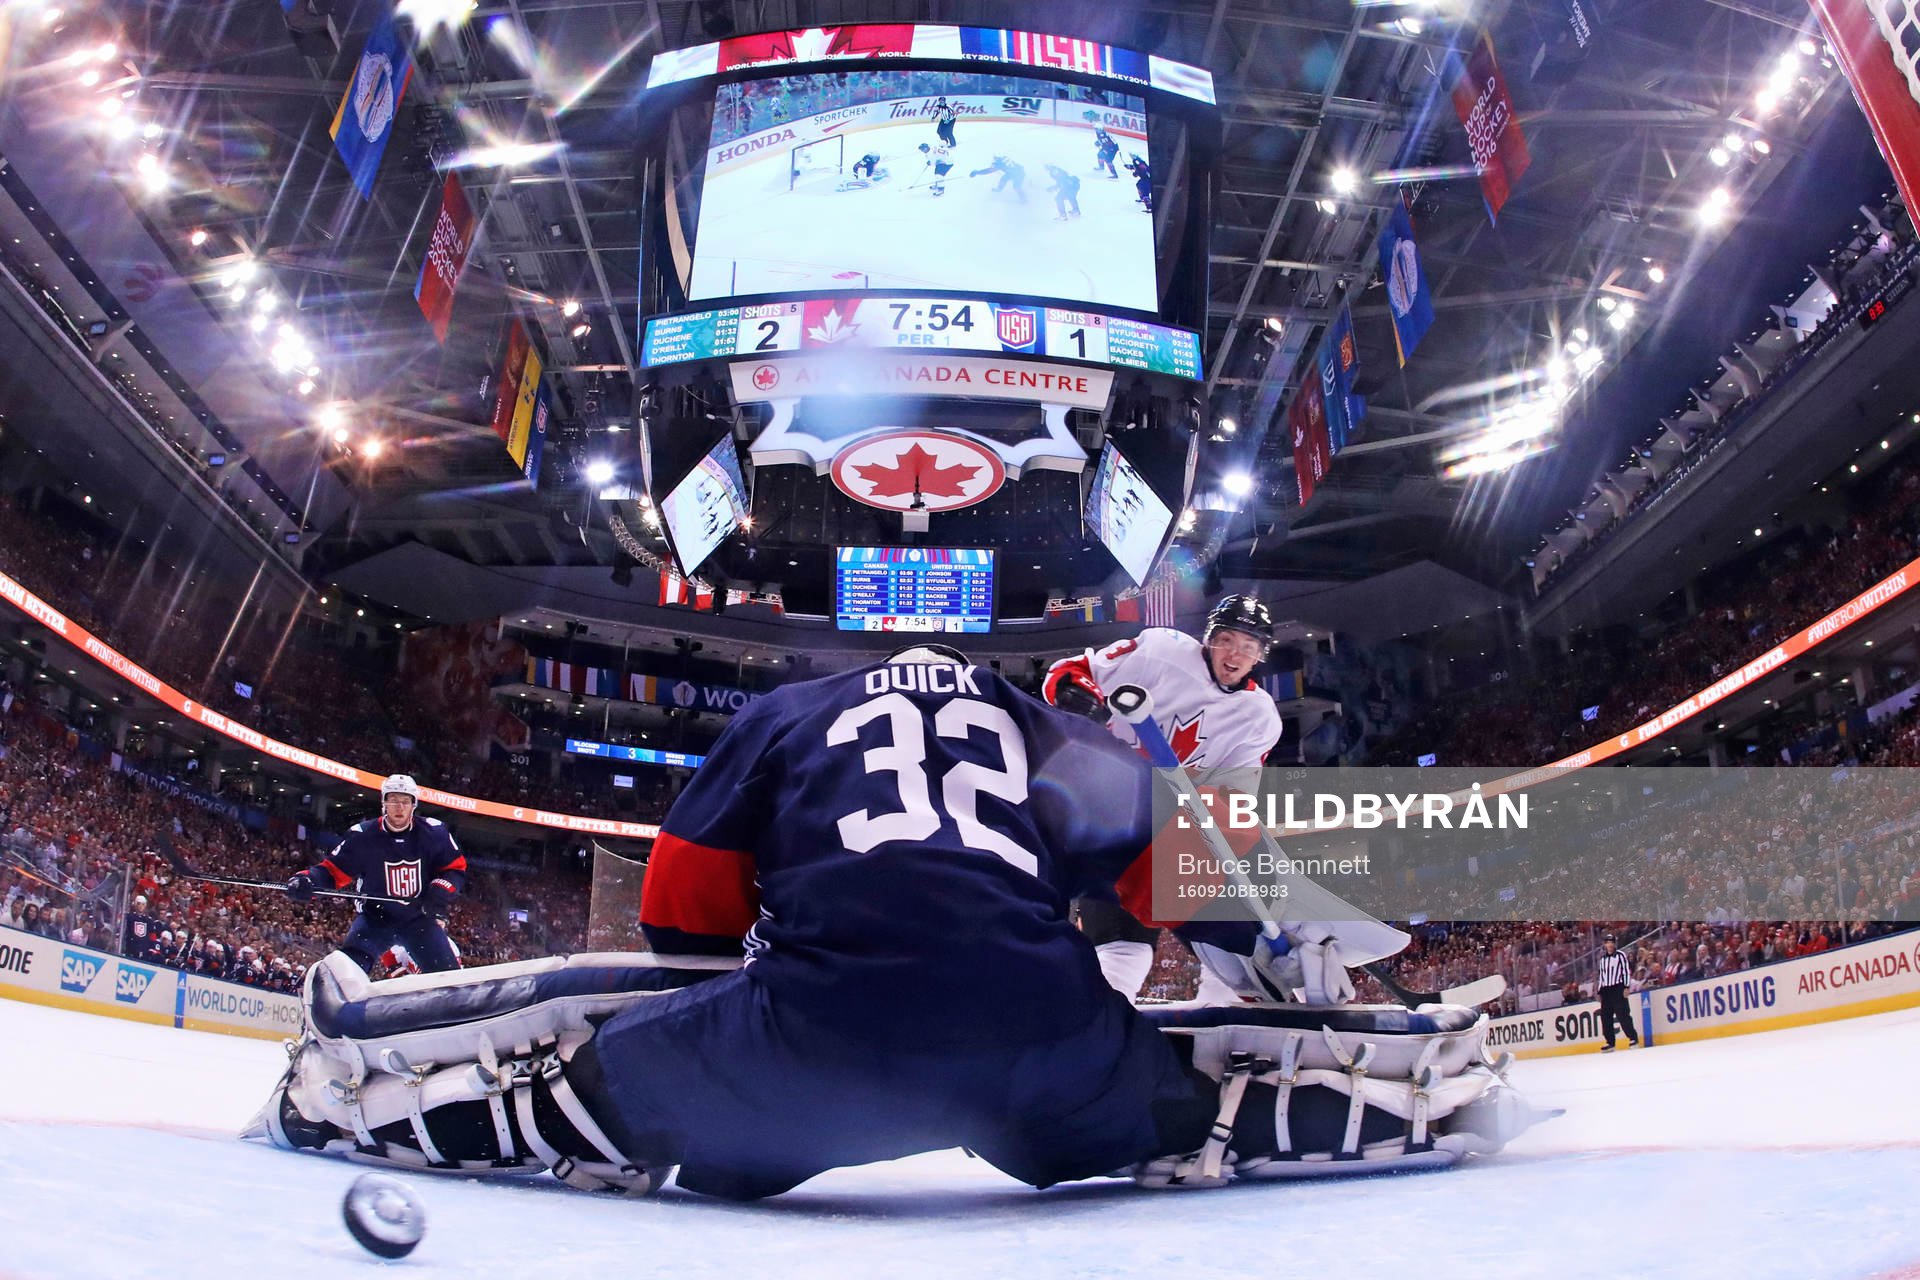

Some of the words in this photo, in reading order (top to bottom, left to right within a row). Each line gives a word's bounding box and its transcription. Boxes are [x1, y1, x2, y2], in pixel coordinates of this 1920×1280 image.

[889, 101, 917, 119] Tim
[920, 99, 988, 116] Htons.
[1001, 96, 1042, 111] SN
[1464, 76, 1496, 134] WORLD
[1468, 114, 1486, 148] CUP
[1471, 99, 1507, 163] HOCKEY
[716, 128, 797, 164] HONDA
[655, 312, 712, 326] PIETRANGELO
[744, 305, 782, 318] SHOTS
[790, 304, 797, 313] 5
[888, 303, 974, 331] 7:54
[1049, 310, 1086, 324] SHOTS
[1094, 316, 1101, 325] 8
[654, 326, 682, 336] BURNS
[1108, 318, 1148, 330] JOHNSON
[653, 334, 692, 346] DUCHENE
[755, 320, 780, 351] 2
[897, 333, 934, 346] PER
[1070, 328, 1086, 358] 1
[1109, 328, 1155, 342] BYFUGLIEN
[1109, 337, 1159, 352] PACIORETTY
[650, 352, 695, 364] THORNTON
[651, 344, 687, 354] O'REILLY
[1110, 346, 1144, 358] BACKES
[1110, 356, 1148, 368] PALMIERI
[984, 368, 1089, 393] CENTRE
[24, 594, 67, 634] BETTER.
[1807, 572, 1907, 644] #WINFROMWITHIN
[872, 621, 878, 629] 2
[904, 618, 926, 626] 7:54
[85, 636, 161, 694] #WINFROMWITHIN
[865, 664, 982, 696] QUICK
[1638, 718, 1662, 740] FUEL
[1662, 700, 1698, 730] BETTER.
[1698, 672, 1744, 708] PERFORM
[1744, 647, 1788, 681] BETTER.
[184, 700, 192, 713] G
[200, 710, 226, 730] FUEL
[227, 722, 264, 748] BETTER.
[265, 738, 316, 767] PERFORM
[316, 756, 360, 782] BETTER.
[1620, 734, 1628, 748] G
[510, 754, 530, 766] 301
[628, 748, 636, 760] 3
[826, 692, 1039, 878] 32
[514, 808, 523, 819] G
[536, 812, 566, 826] FUEL
[569, 817, 619, 834] BETTER.
[391, 867, 418, 898] USA
[61, 956, 95, 988] SAP
[1798, 970, 1828, 996] AIR
[1829, 951, 1911, 989] CANADA
[116, 970, 148, 997] SAP
[188, 985, 238, 1014] WORLD
[239, 996, 264, 1018] CUP
[1666, 975, 1776, 1024] SAMSUNG
